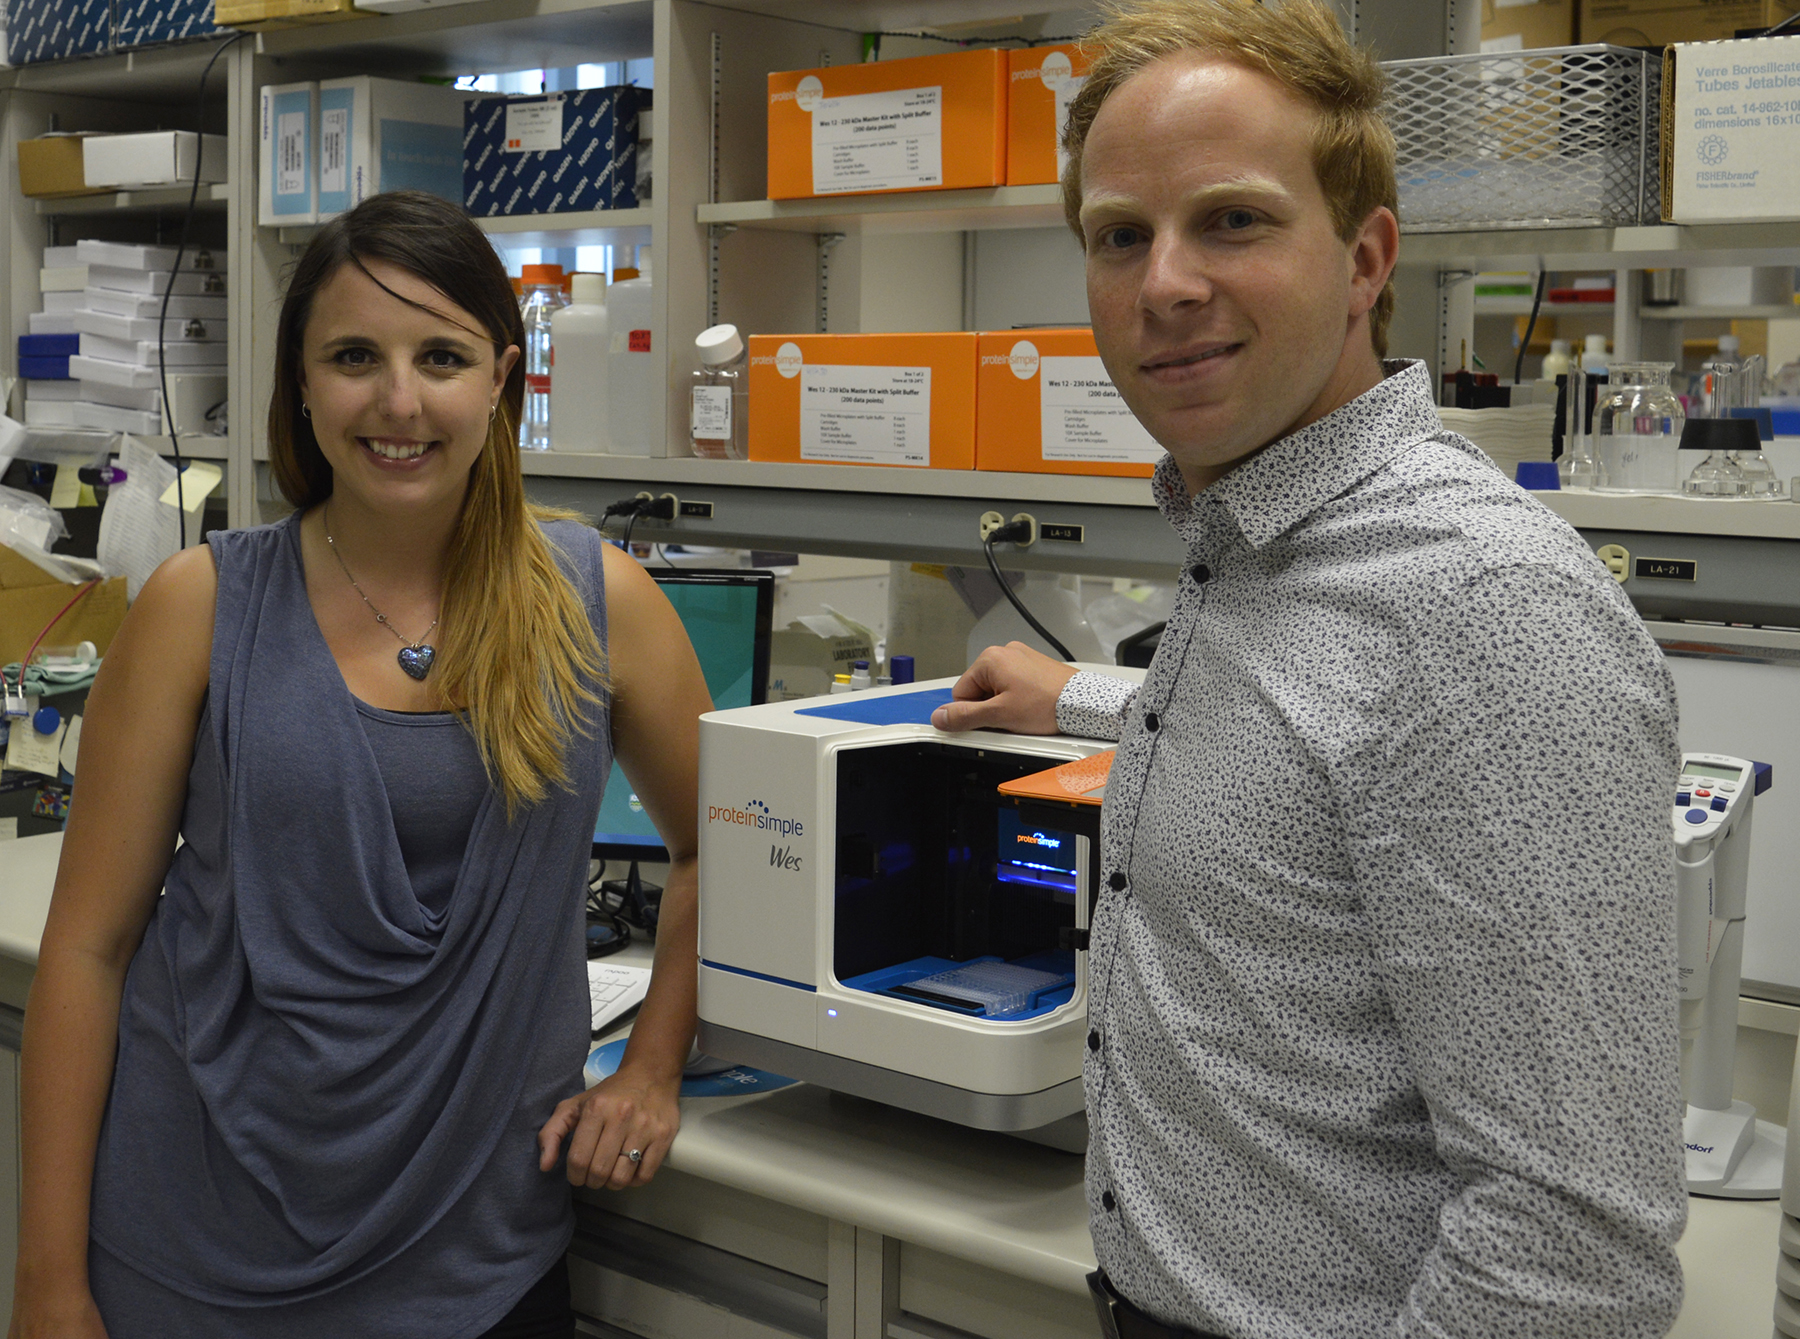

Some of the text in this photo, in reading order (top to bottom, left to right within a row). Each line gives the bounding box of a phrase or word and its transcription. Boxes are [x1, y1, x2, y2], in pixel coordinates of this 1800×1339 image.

[1011, 64, 1070, 84] proteinsimple
[1696, 62, 1800, 78] Verre Borosilicate
[1696, 76, 1800, 92] Tubes Jetables
[770, 88, 823, 104] proteinsimple
[589, 98, 610, 128] QIAGEN
[1694, 107, 1712, 116] no.
[1716, 105, 1736, 116] cat.
[563, 115, 583, 145] QIAGEN
[1694, 117, 1760, 129] dimensions
[578, 137, 599, 167] QIAGEN
[552, 154, 573, 183] QIAGEN
[568, 176, 589, 205] QIAGEN
[751, 354, 802, 367] proteinsimple
[981, 354, 1038, 367] proteinsimple
[1650, 565, 1679, 575] LA-21
[832, 647, 870, 661] LABORATORY
[709, 806, 803, 838] proteinsimple
[770, 844, 802, 872] Wes
[1684, 1142, 1714, 1154] ndorf
